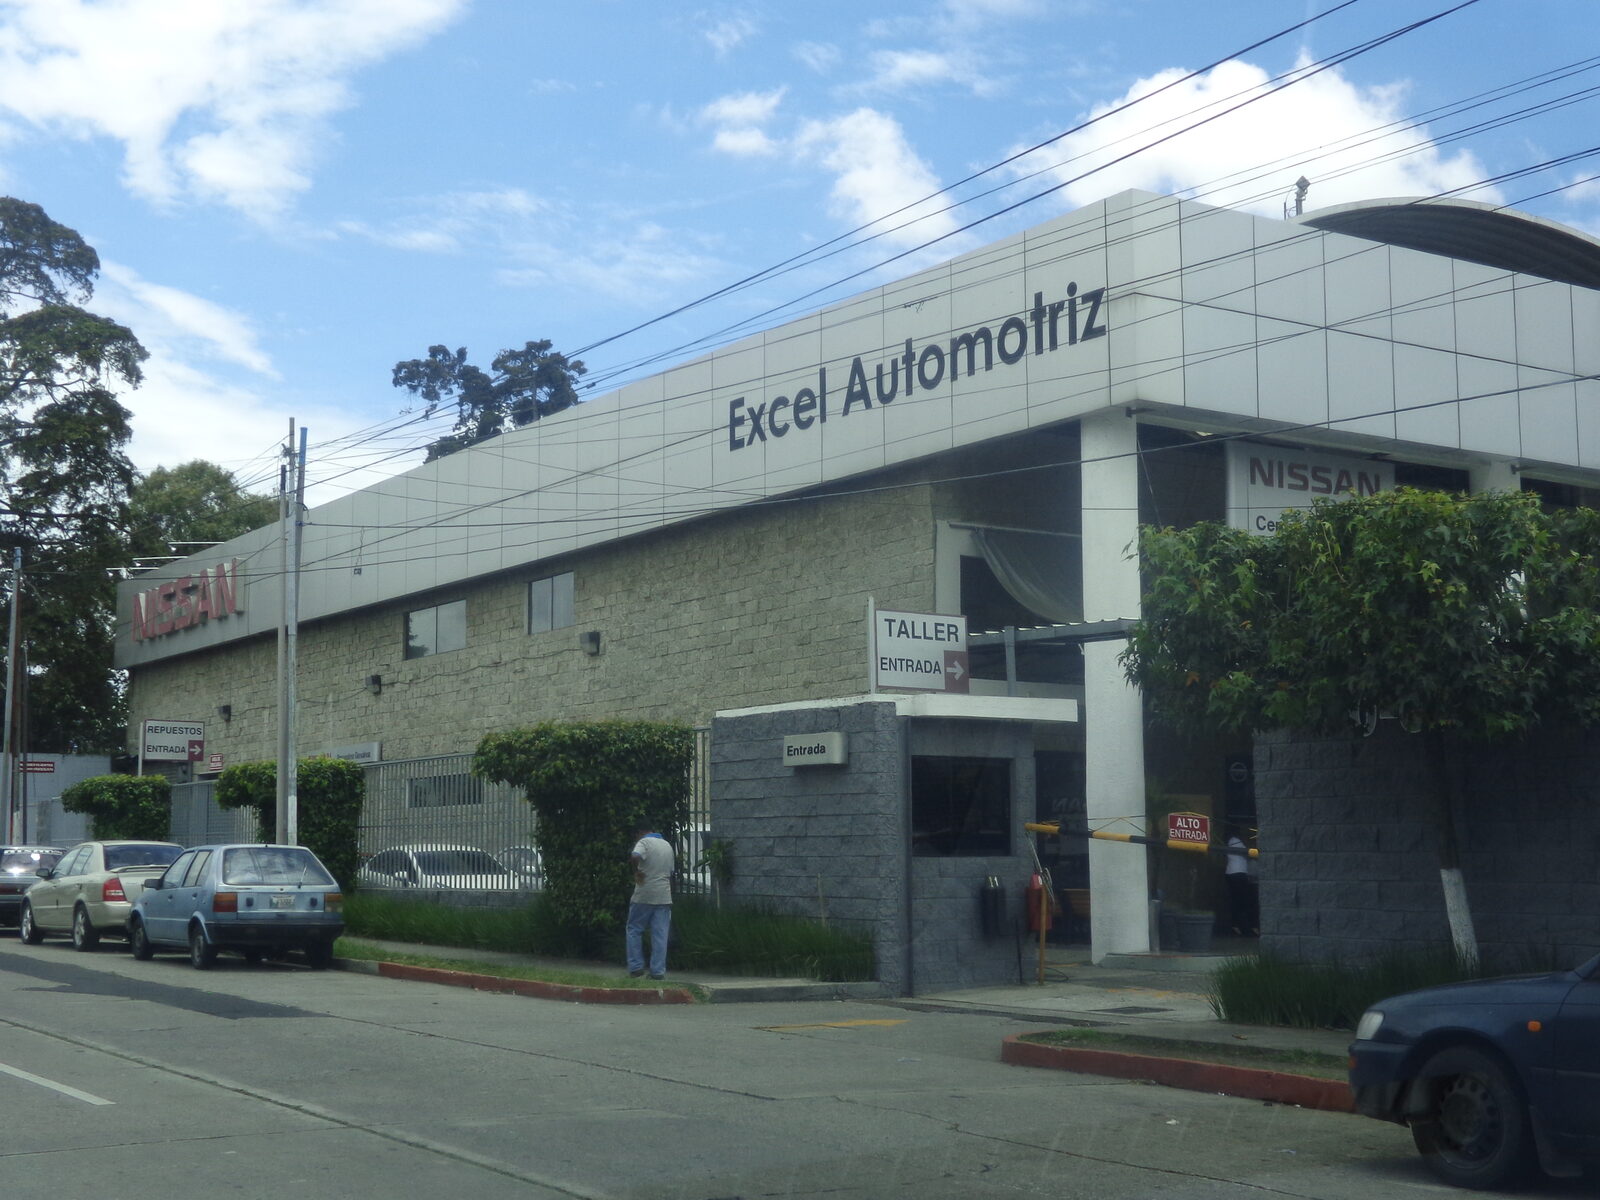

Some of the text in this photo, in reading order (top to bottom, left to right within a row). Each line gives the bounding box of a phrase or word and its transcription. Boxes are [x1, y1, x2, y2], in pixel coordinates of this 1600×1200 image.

[729, 281, 1107, 452] Excel Automotriz
[1250, 457, 1381, 497] NISSAN
[131, 558, 243, 642] NISSAN
[884, 618, 959, 642] TALLER
[880, 657, 942, 674] ENTRADA
[147, 725, 202, 736] REPUESTOS
[146, 744, 186, 754] ENTRADA
[786, 743, 826, 757] Entrada
[1176, 817, 1200, 829] ALTO
[1169, 828, 1208, 841] ENTRADA
